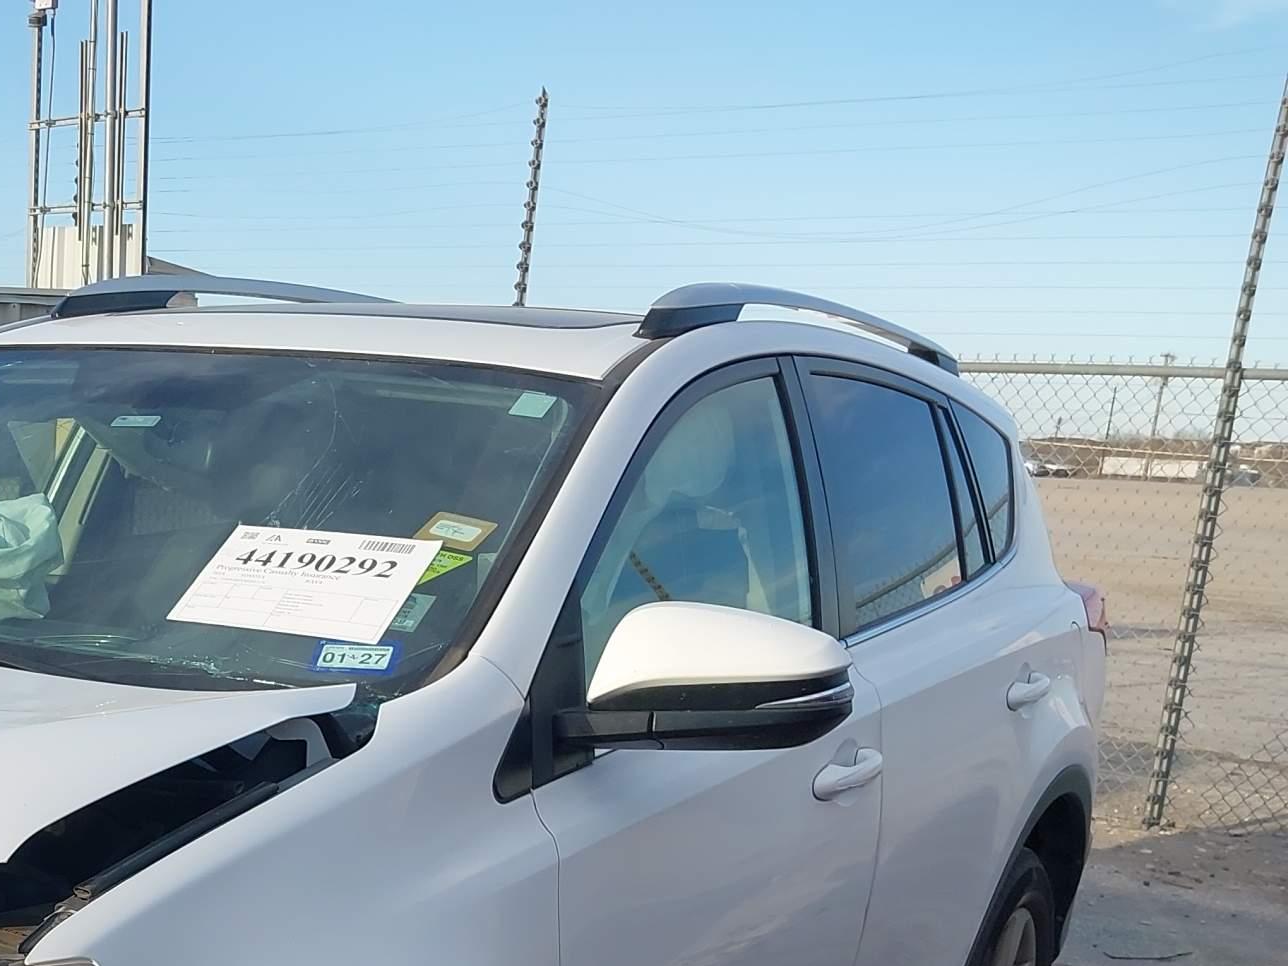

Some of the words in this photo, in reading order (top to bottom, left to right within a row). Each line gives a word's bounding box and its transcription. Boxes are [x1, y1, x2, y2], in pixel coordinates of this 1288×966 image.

[235, 547, 398, 579] 44190292
[322, 652, 346, 664] 01
[358, 653, 387, 665] 27
